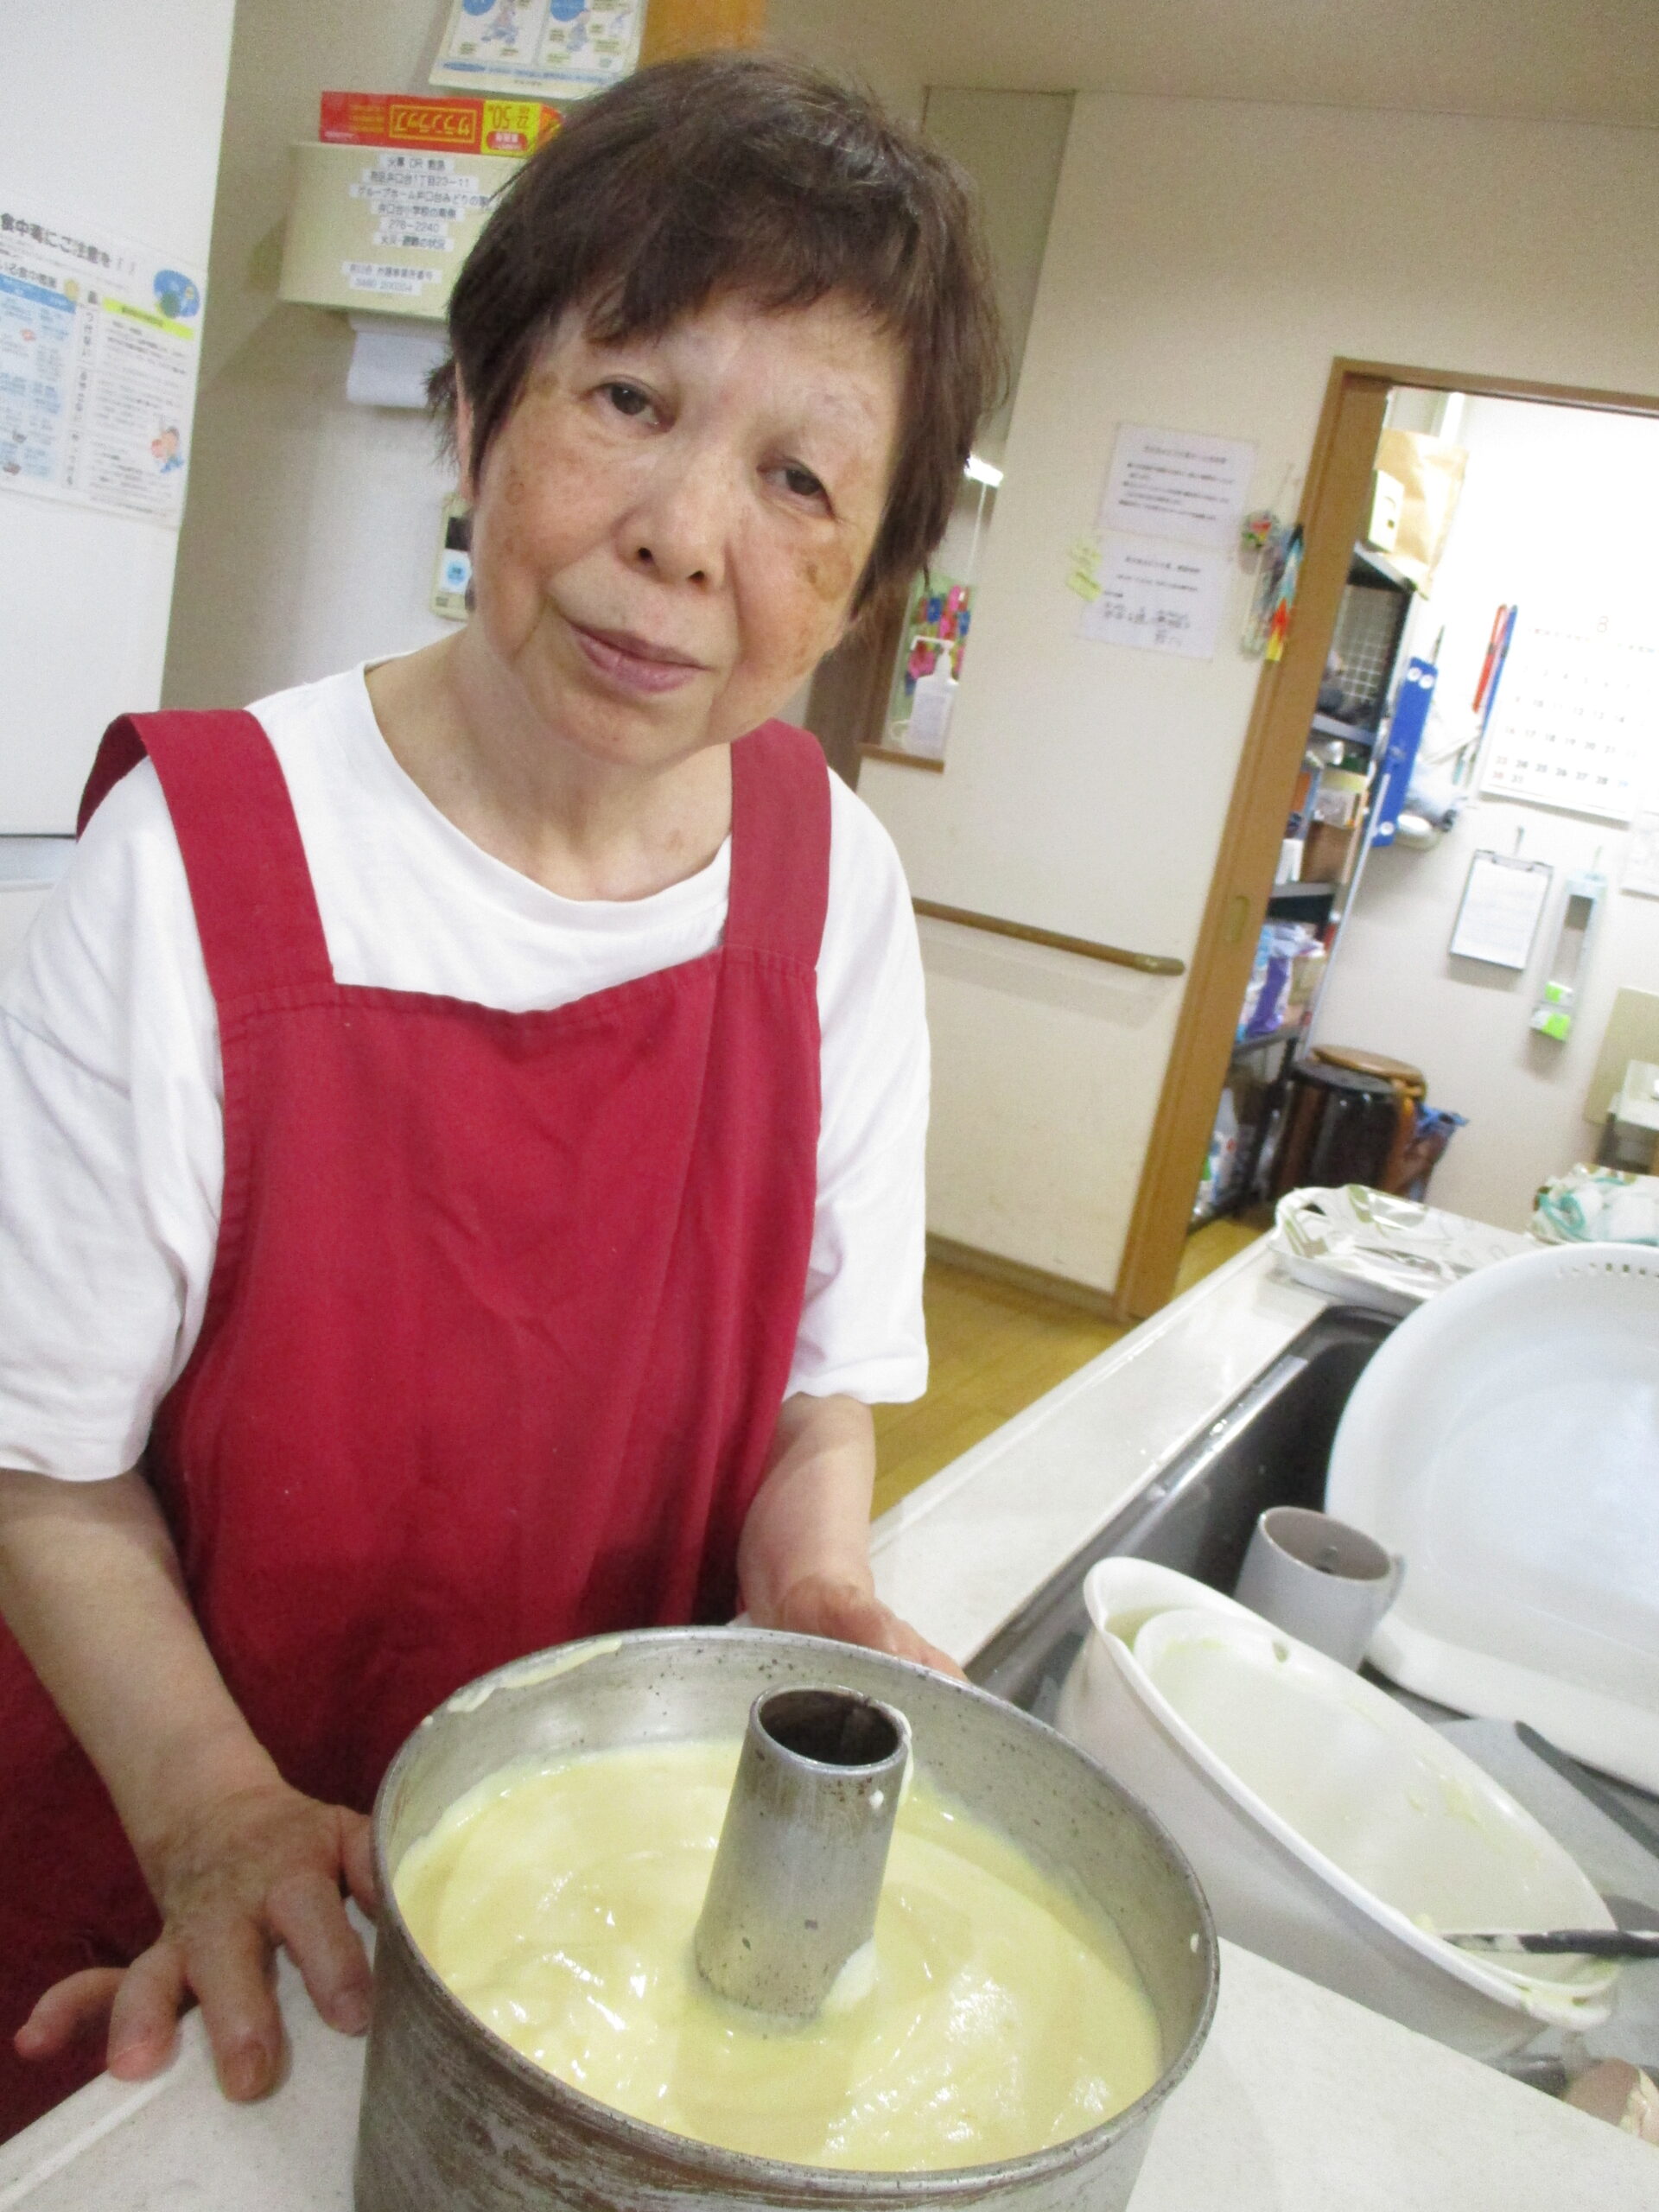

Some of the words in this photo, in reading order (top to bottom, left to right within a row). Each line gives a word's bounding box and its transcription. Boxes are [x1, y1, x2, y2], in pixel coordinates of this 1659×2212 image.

[395, 110, 472, 137] サランラップ
[1596, 615, 1610, 633] 8
[1533, 698, 1545, 709] 10
[1525, 729, 1538, 739] 17
[1545, 734, 1557, 743] 18
[1564, 737, 1578, 747] 19
[1584, 741, 1597, 751] 20
[1535, 763, 1548, 773] 25
[1554, 767, 1569, 778] 26
[1575, 771, 1590, 781] 27
[1595, 775, 1610, 785] 28
